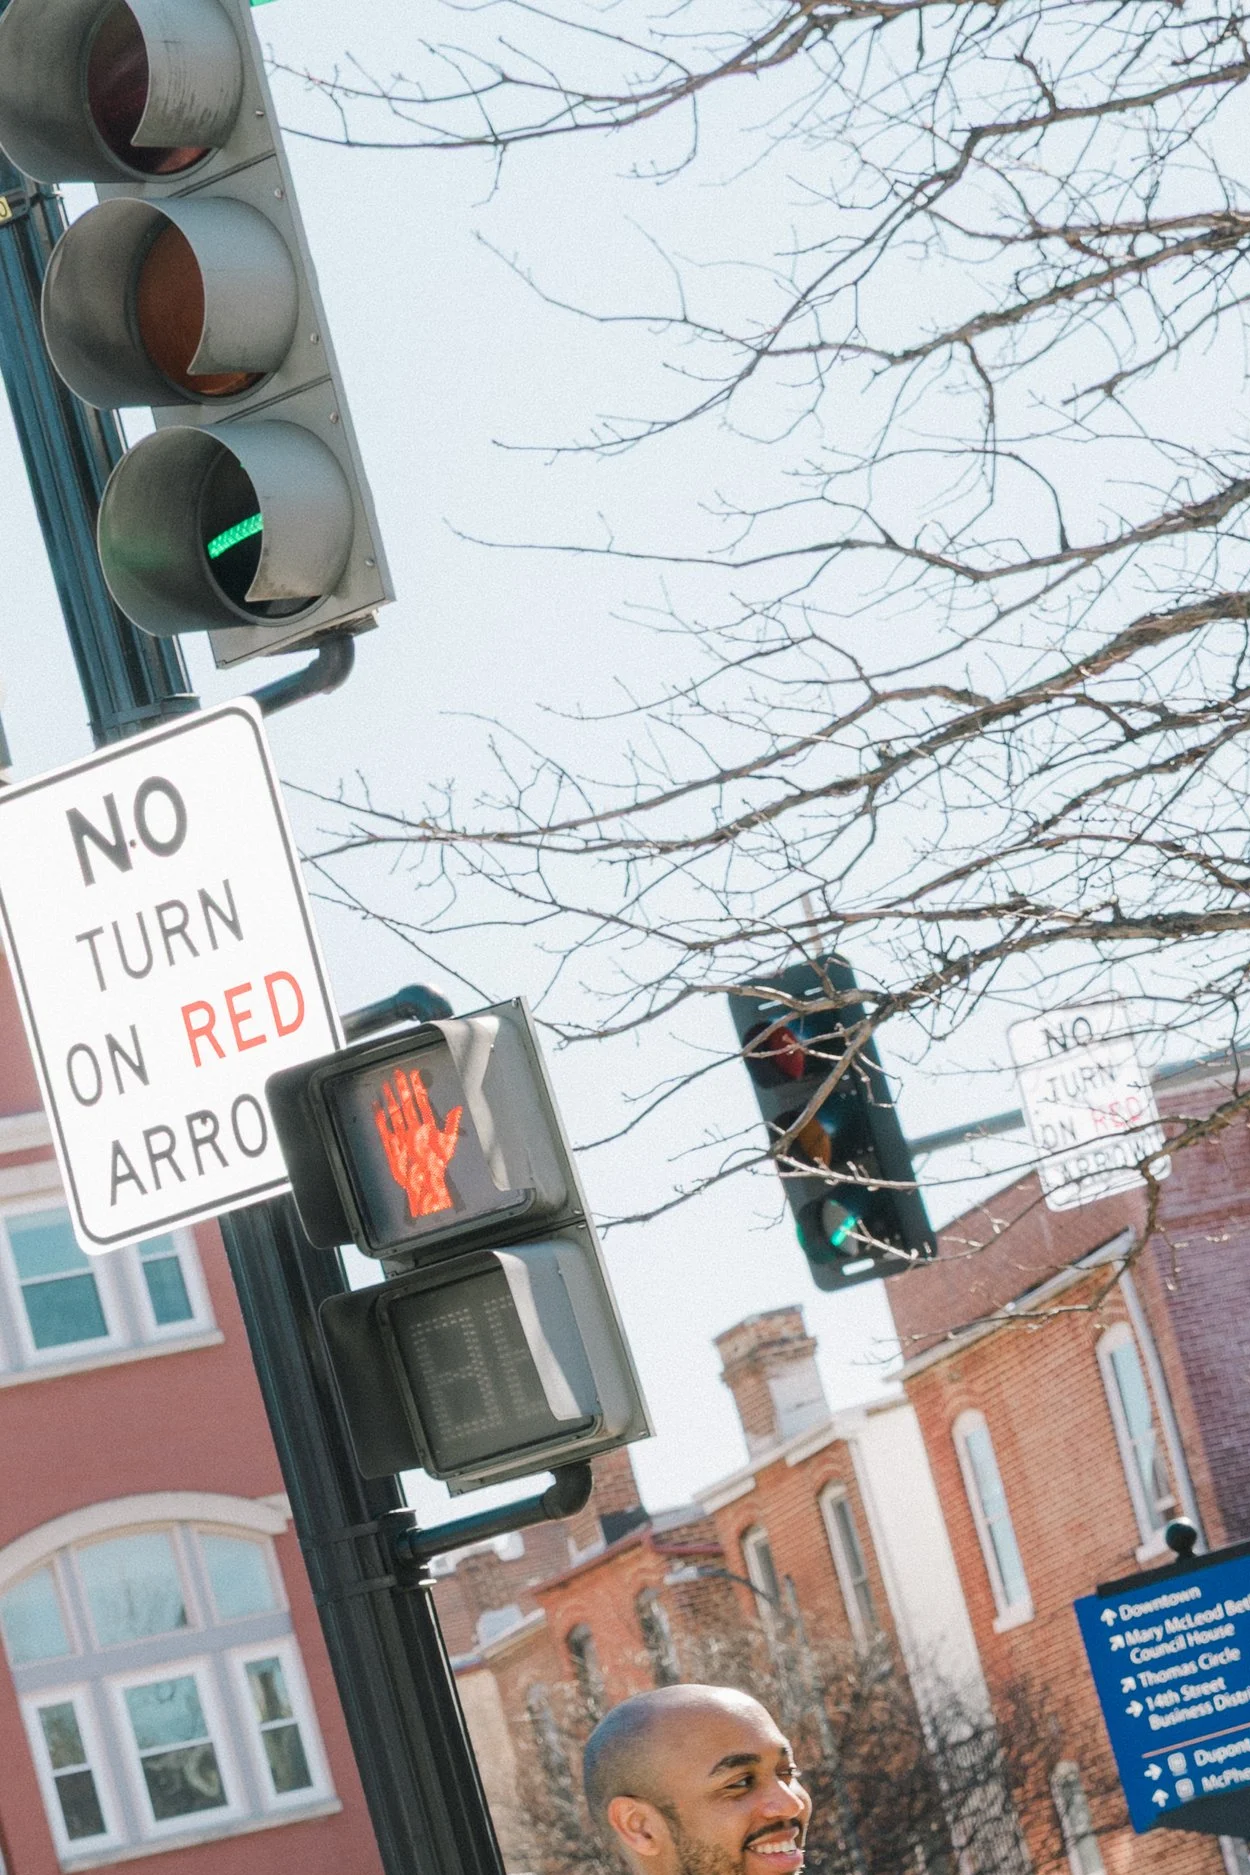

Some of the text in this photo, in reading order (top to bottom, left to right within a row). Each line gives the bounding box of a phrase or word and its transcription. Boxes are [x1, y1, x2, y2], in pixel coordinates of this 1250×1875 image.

[65, 775, 188, 887] NO
[75, 878, 245, 993] TURN
[66, 971, 305, 1107] ON RED
[1042, 1017, 1093, 1056] NO
[1047, 1060, 1116, 1103] TURN
[1042, 1097, 1143, 1148] ON RED
[110, 1093, 268, 1206] ARRO
[1119, 1587, 1201, 1620] Downtown
[1125, 1626, 1163, 1646] Mary
[1165, 1603, 1224, 1634] McLeod
[1130, 1623, 1234, 1664] Council House
[1137, 1647, 1240, 1687] Thomas Circle
[1146, 1677, 1226, 1710] 14th Street
[1149, 1702, 1213, 1730] Business
